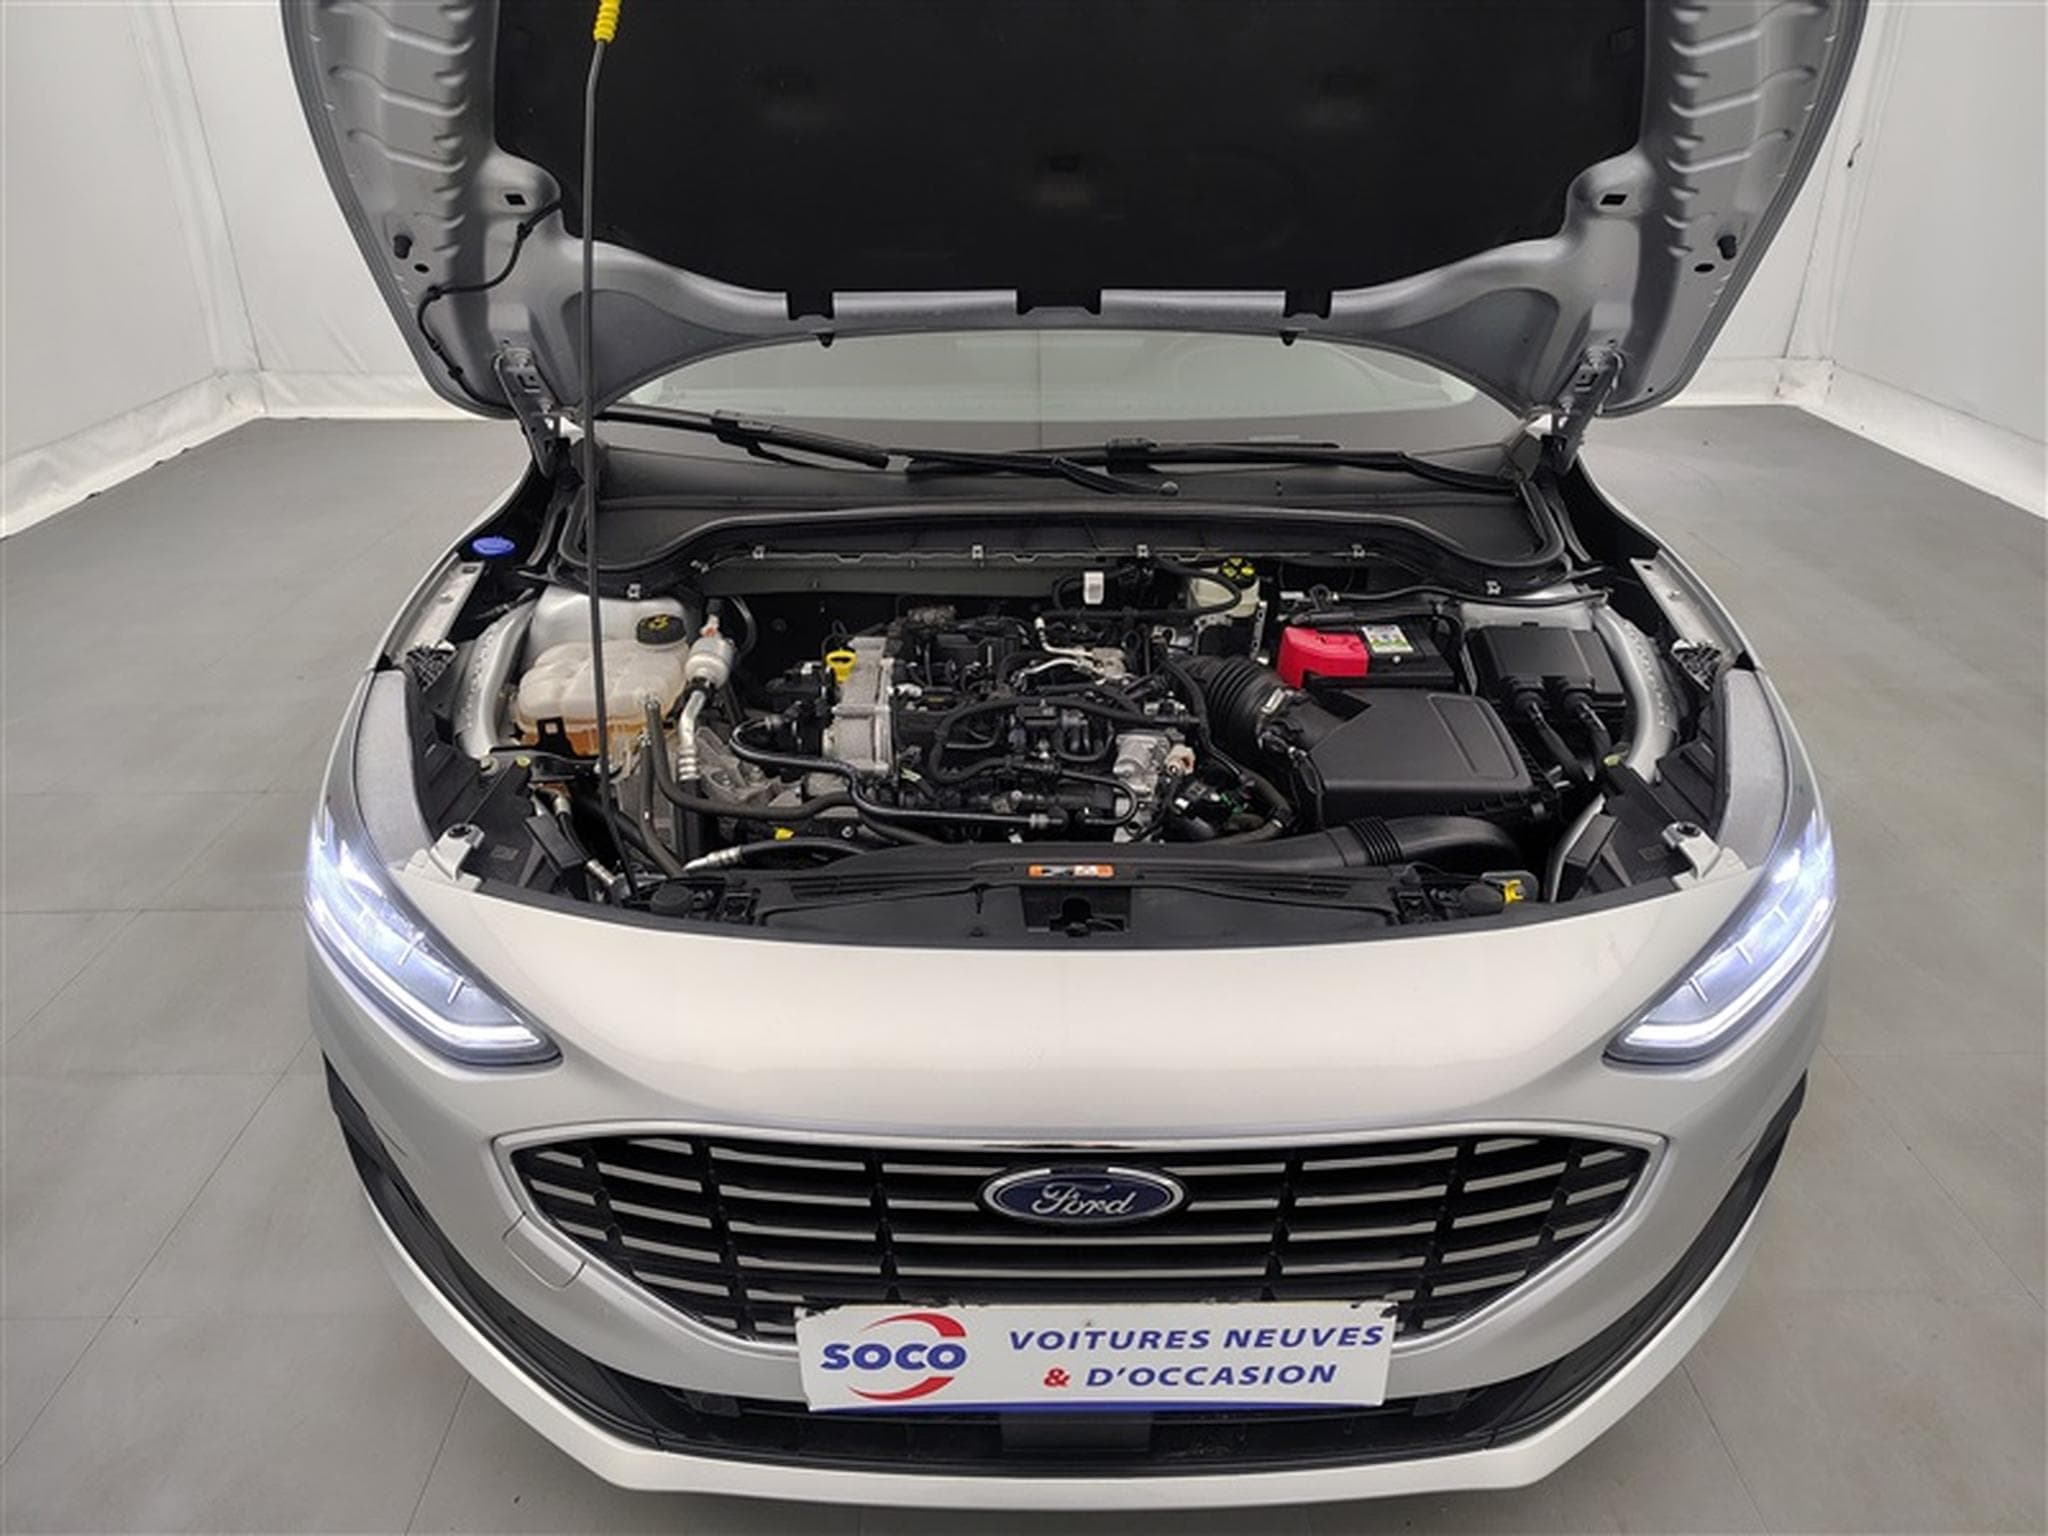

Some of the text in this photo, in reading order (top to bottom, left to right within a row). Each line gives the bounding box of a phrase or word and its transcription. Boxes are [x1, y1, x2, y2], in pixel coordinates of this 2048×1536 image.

[1031, 1181, 1138, 1215] Ford
[1009, 1326, 1385, 1351] VOITURES NEUVES
[820, 1343, 968, 1371] SOCO
[1043, 1364, 1337, 1389] & D'OCCASION
